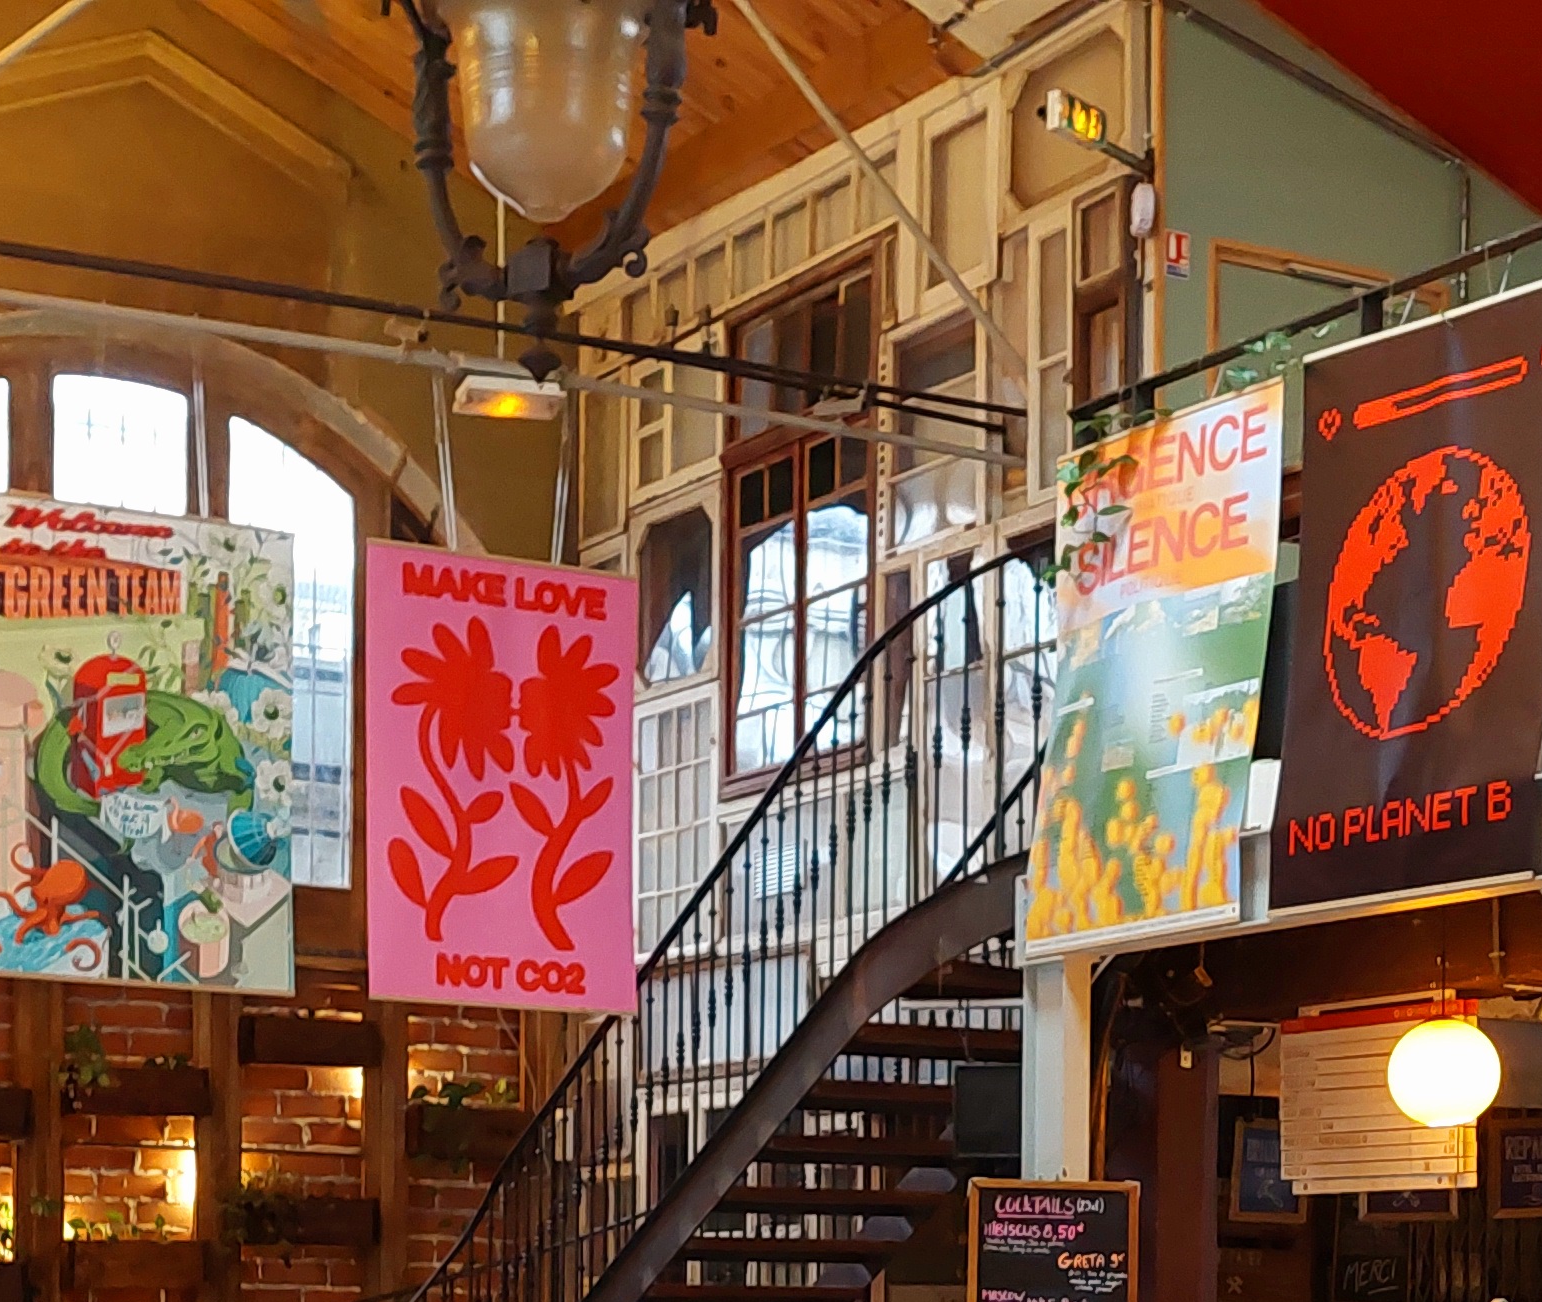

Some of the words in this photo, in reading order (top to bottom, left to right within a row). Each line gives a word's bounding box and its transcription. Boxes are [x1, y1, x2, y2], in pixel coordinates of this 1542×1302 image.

[1077, 491, 1250, 596] SILENCE
[4, 565, 107, 619] GREEN
[115, 568, 181, 617] TEAM
[402, 561, 507, 608] MAKE
[514, 570, 608, 621] LOVE
[1288, 810, 1337, 855] NO
[1344, 786, 1477, 847] PLANET
[1487, 779, 1512, 822] B
[435, 953, 509, 988] NOT
[516, 962, 586, 995] CO2
[995, 1194, 1075, 1215] COCKTAILS
[984, 1220, 1040, 1238] HIBISCUS
[1057, 1251, 1105, 1269] GRETA
[1343, 1258, 1397, 1292] MERCI
